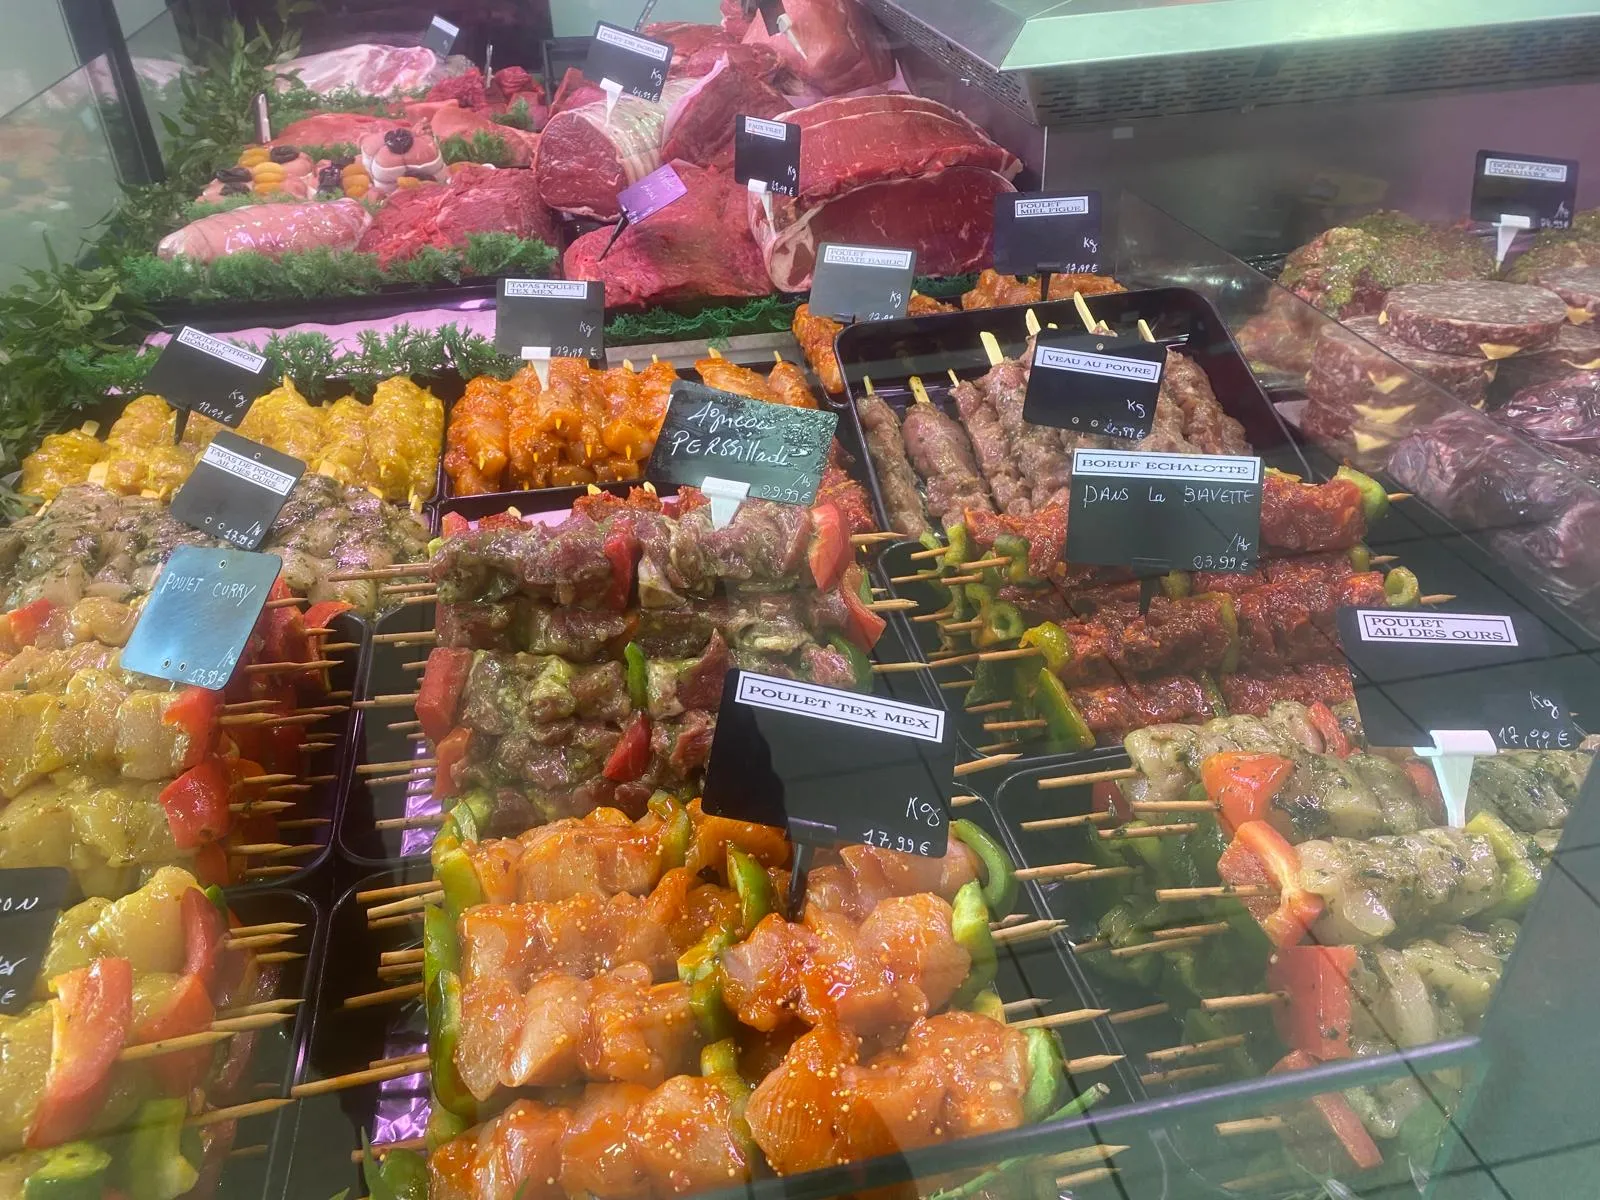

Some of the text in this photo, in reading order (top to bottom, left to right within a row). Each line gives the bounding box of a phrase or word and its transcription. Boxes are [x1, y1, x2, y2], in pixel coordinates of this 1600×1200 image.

[830, 248, 864, 256] POULET
[183, 335, 225, 357] ROMARIN
[186, 330, 257, 363] POULET CITRON
[1047, 354, 1152, 376] VEAU AU POIVRE
[209, 446, 290, 486] TAPAS DE POULET
[216, 458, 278, 489] AIL DES OURS
[1082, 458, 1249, 475] BOEUF ECHALOTTE
[804, 491, 812, 503] €
[1083, 484, 1129, 508] DANS
[1240, 558, 1249, 571] €
[160, 571, 257, 607] POULET CURRY
[1371, 617, 1445, 629] POULET
[1374, 627, 1505, 641] AIL DES OURS
[748, 684, 931, 729] POULET TEX MEX
[1528, 691, 1560, 720] Kg
[1557, 730, 1571, 748] €
[906, 796, 941, 827] Kg
[863, 829, 931, 856] 17,99 €
[0, 896, 39, 912] ON
